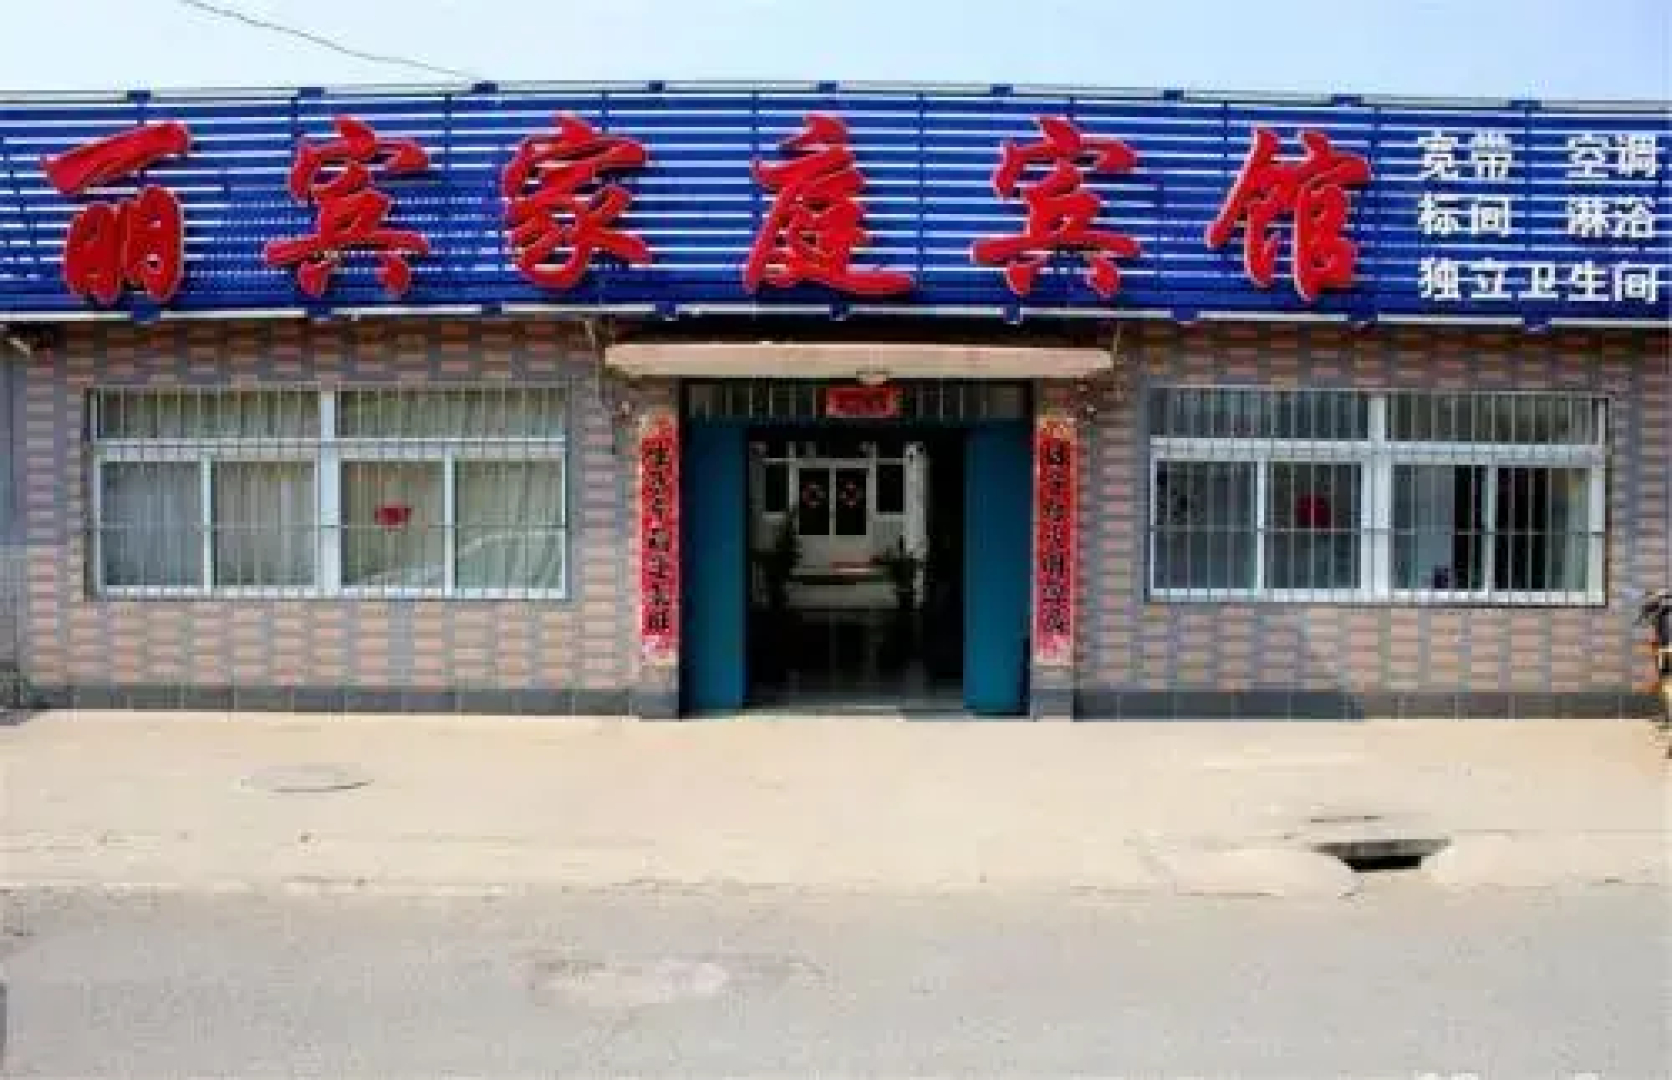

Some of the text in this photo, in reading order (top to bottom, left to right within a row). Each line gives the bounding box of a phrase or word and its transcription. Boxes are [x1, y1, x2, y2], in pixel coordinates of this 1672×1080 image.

[1418, 129, 1656, 181] 宽带 空调
[40, 113, 1371, 303] 丽宾家庭宾馆
[1418, 192, 1656, 238] 标间 淋浴
[1418, 257, 1659, 304] 独立卫生间
